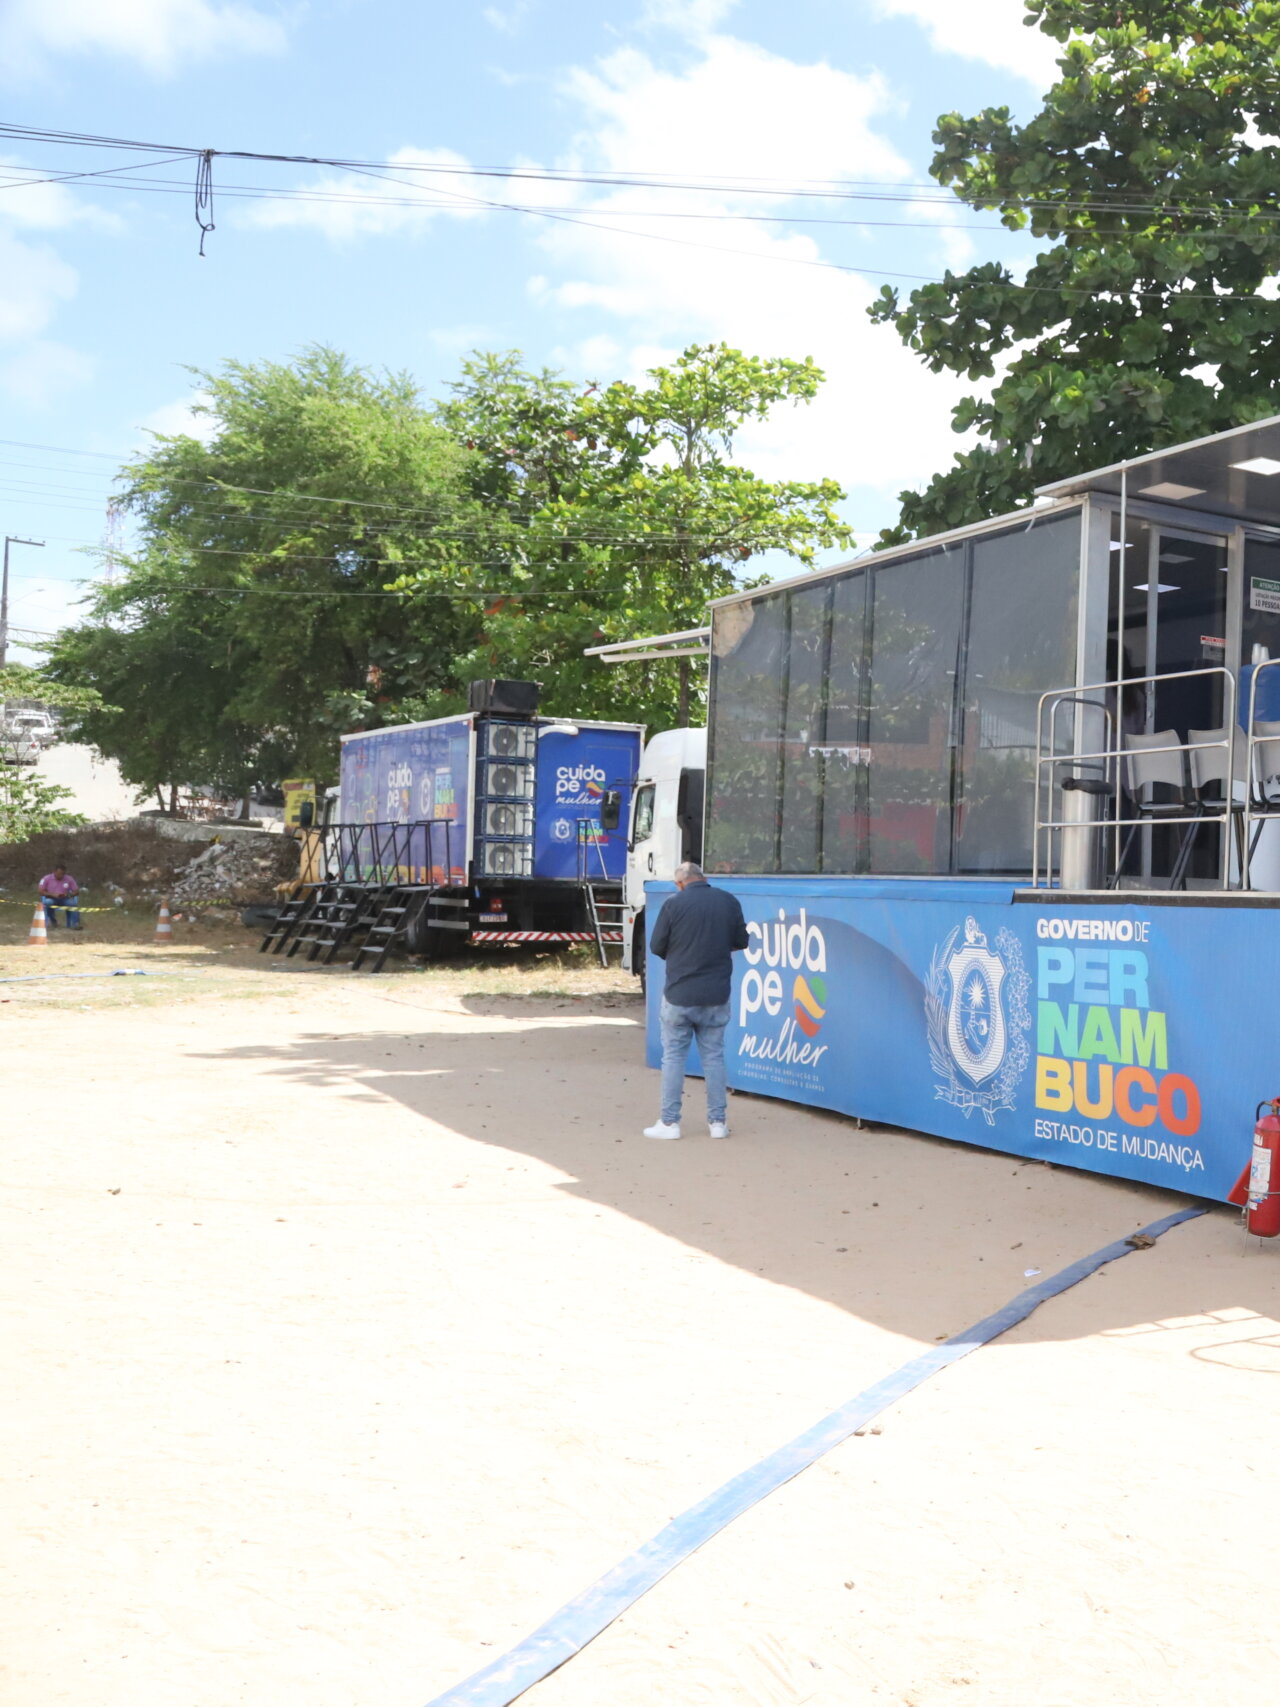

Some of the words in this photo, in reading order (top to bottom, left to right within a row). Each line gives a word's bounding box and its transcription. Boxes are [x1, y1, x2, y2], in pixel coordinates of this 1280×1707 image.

[1255, 599, 1261, 607] 10
[1259, 582, 1280, 591] ATENÇÃO
[388, 762, 412, 788] cuida
[556, 764, 606, 782] cuida
[556, 780, 580, 796] pe
[555, 791, 603, 806] mulher
[743, 907, 827, 973] cuida
[1036, 918, 1133, 941] GOVERNO
[1134, 921, 1150, 943] DE
[1036, 945, 1150, 1009] PER
[739, 968, 783, 1028] pe
[738, 1016, 829, 1068] mulher
[1036, 1000, 1169, 1071] NAM
[1035, 1055, 1202, 1137] BUCO
[1034, 1118, 1094, 1147] ESTADO
[1096, 1129, 1118, 1152] DE
[1121, 1134, 1205, 1172] MUDANÇA
